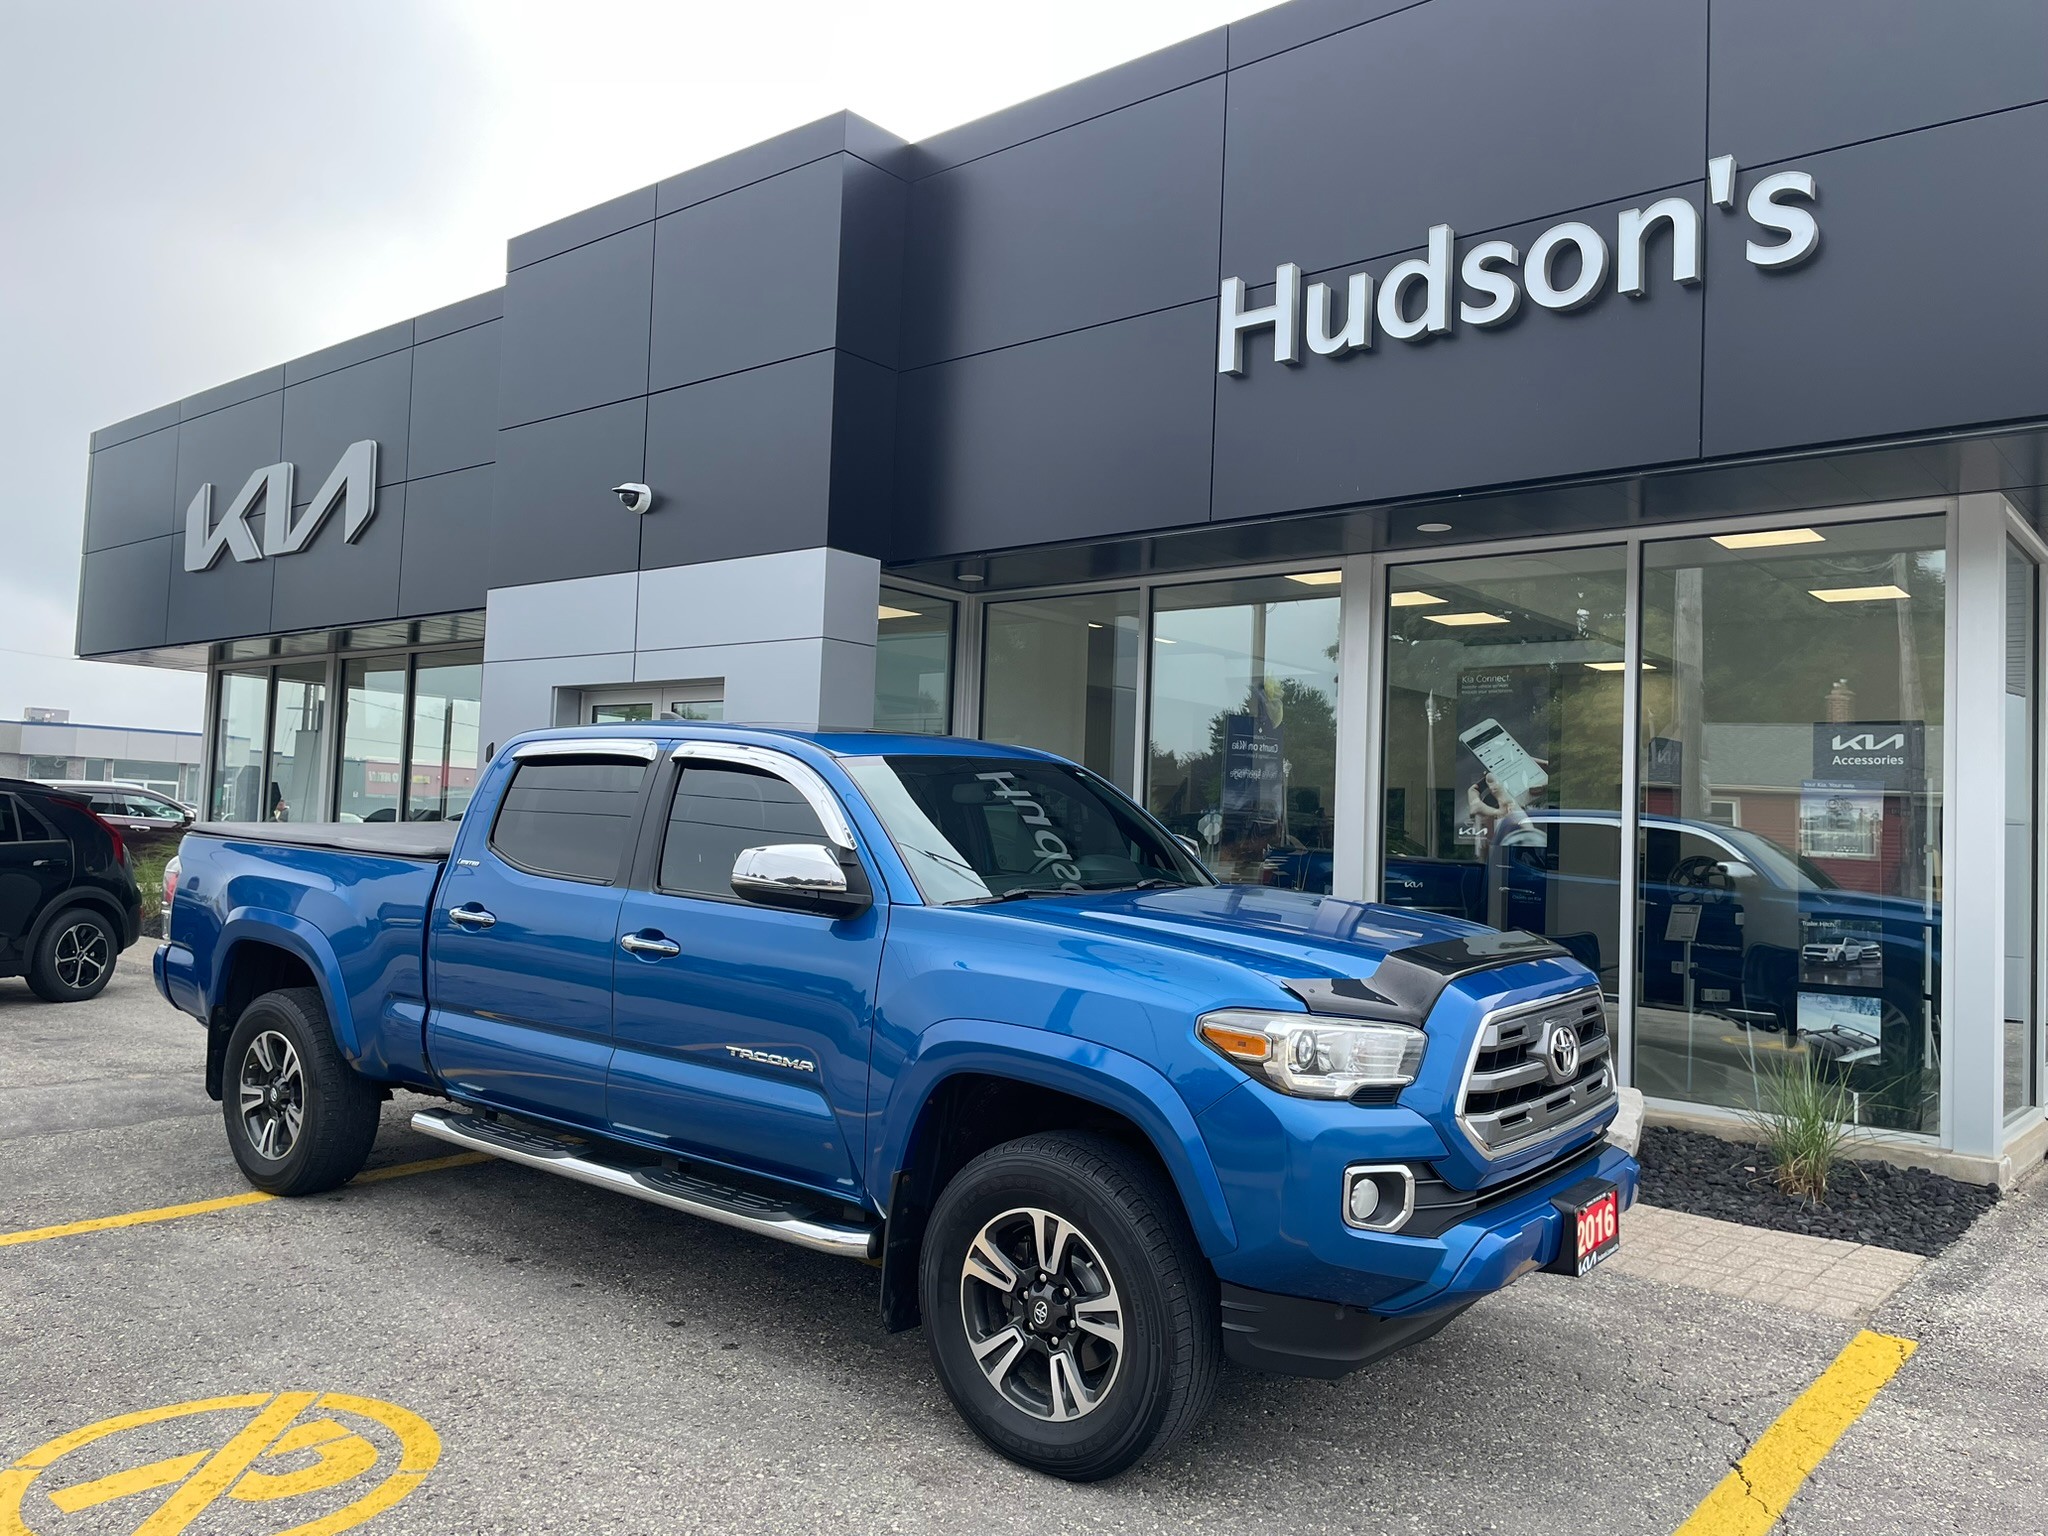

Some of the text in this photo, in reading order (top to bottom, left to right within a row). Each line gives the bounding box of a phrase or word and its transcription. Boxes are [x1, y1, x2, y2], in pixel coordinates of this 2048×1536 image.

[1218, 153, 1820, 376] Hudson's
[184, 439, 378, 572] KIA
[1461, 675, 1474, 684] Kia
[1832, 733, 1904, 750] KIA
[1832, 755, 1904, 766] Accessories
[1458, 827, 1488, 836] KIA
[725, 1045, 815, 1073] TACOMA
[1578, 1202, 1614, 1258] 2016
[1578, 1250, 1597, 1277] KIA
